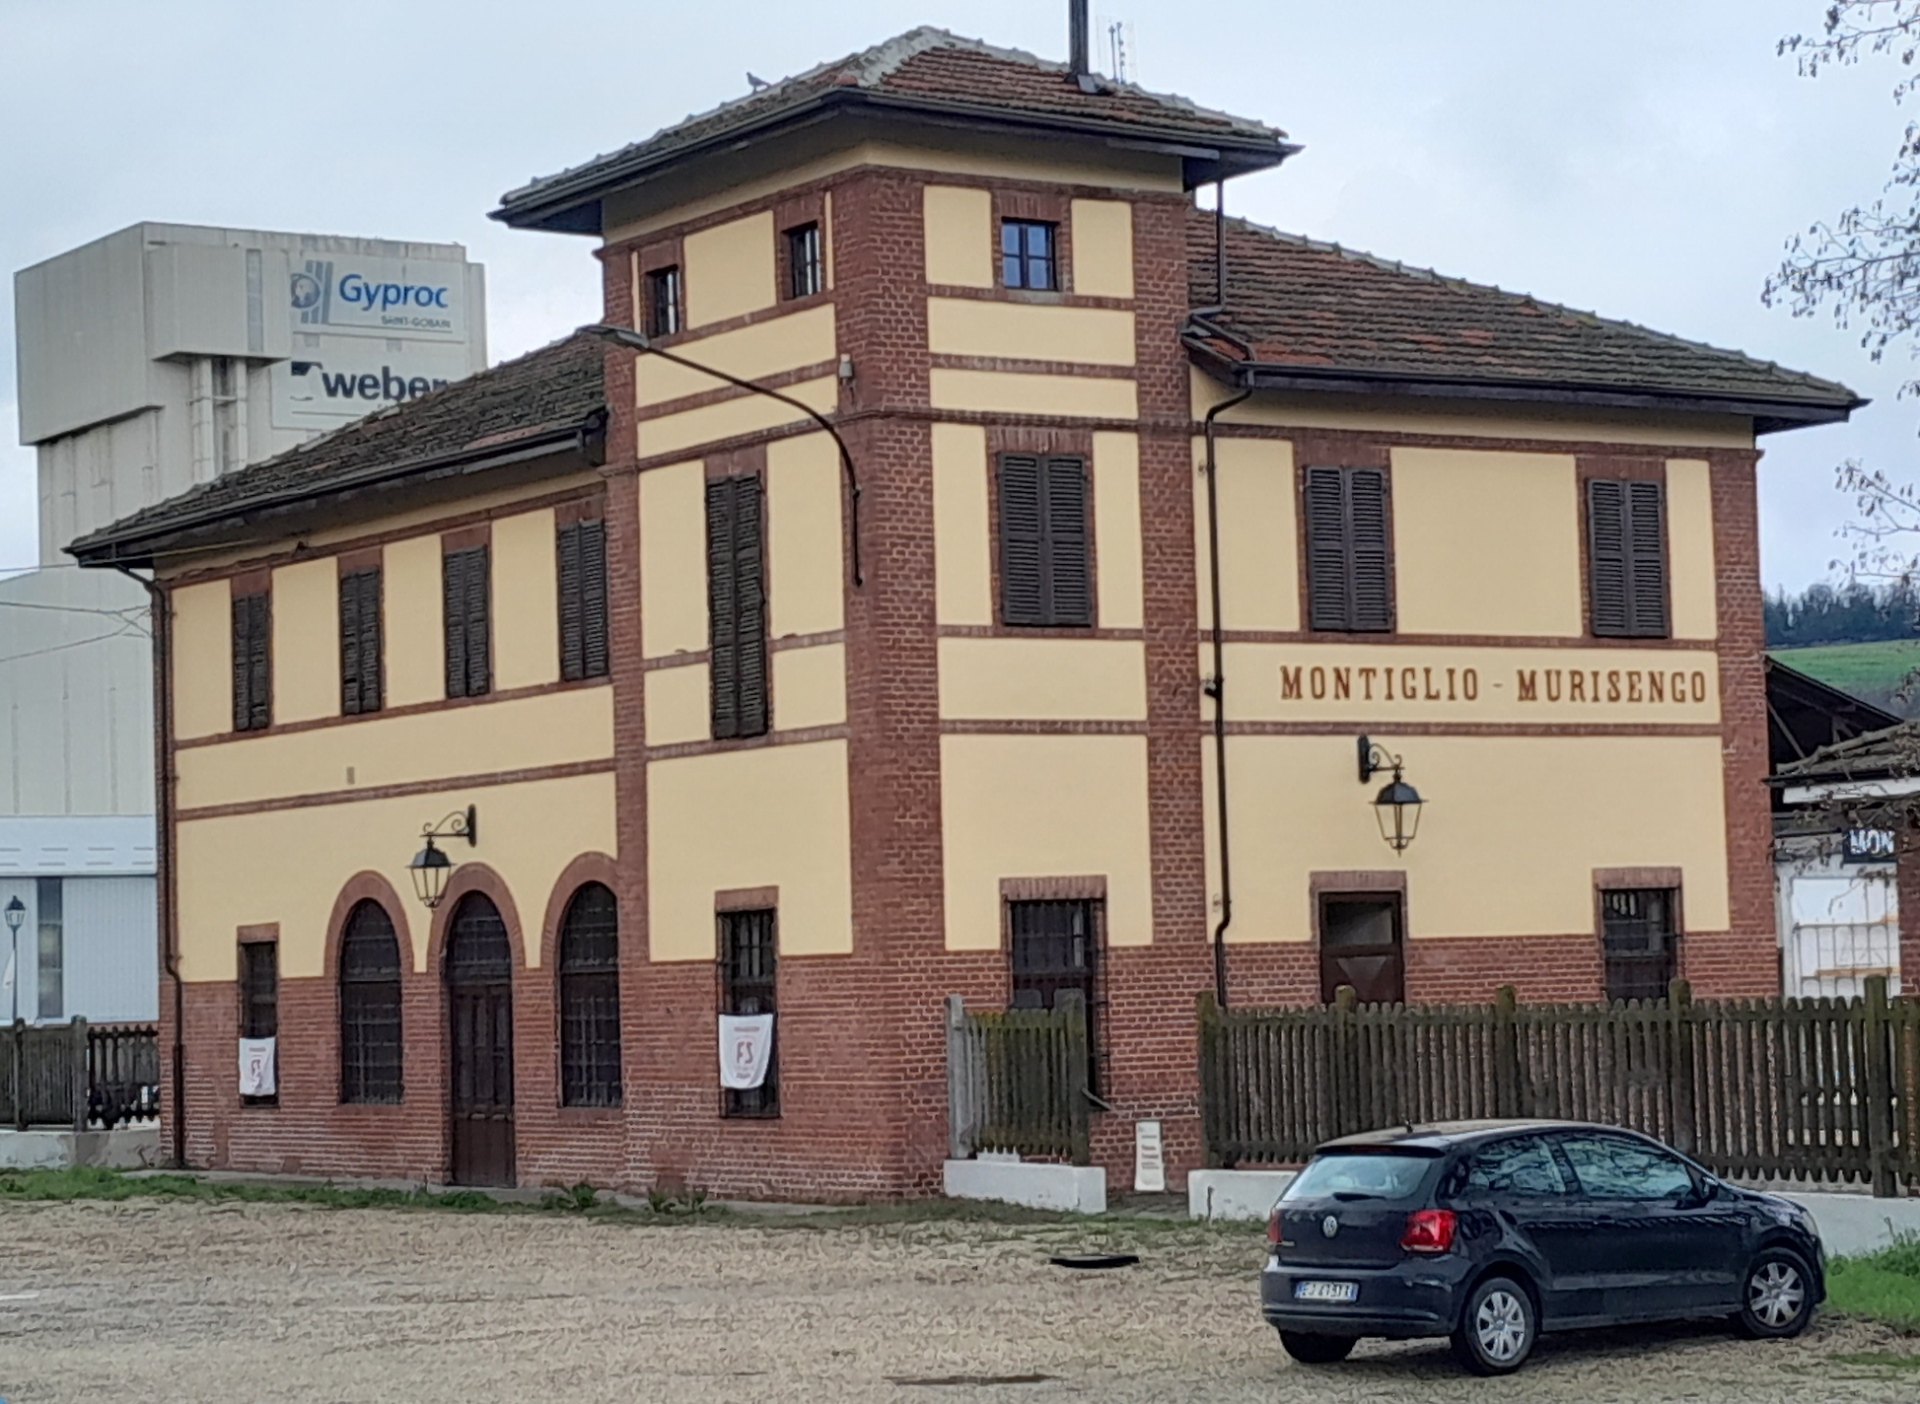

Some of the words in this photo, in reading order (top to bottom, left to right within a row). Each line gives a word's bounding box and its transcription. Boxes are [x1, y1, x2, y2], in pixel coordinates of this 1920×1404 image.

[338, 273, 449, 312] Gyproc
[1280, 665, 1479, 701] MONTIGLIO
[1516, 668, 1707, 703] MURISENGO
